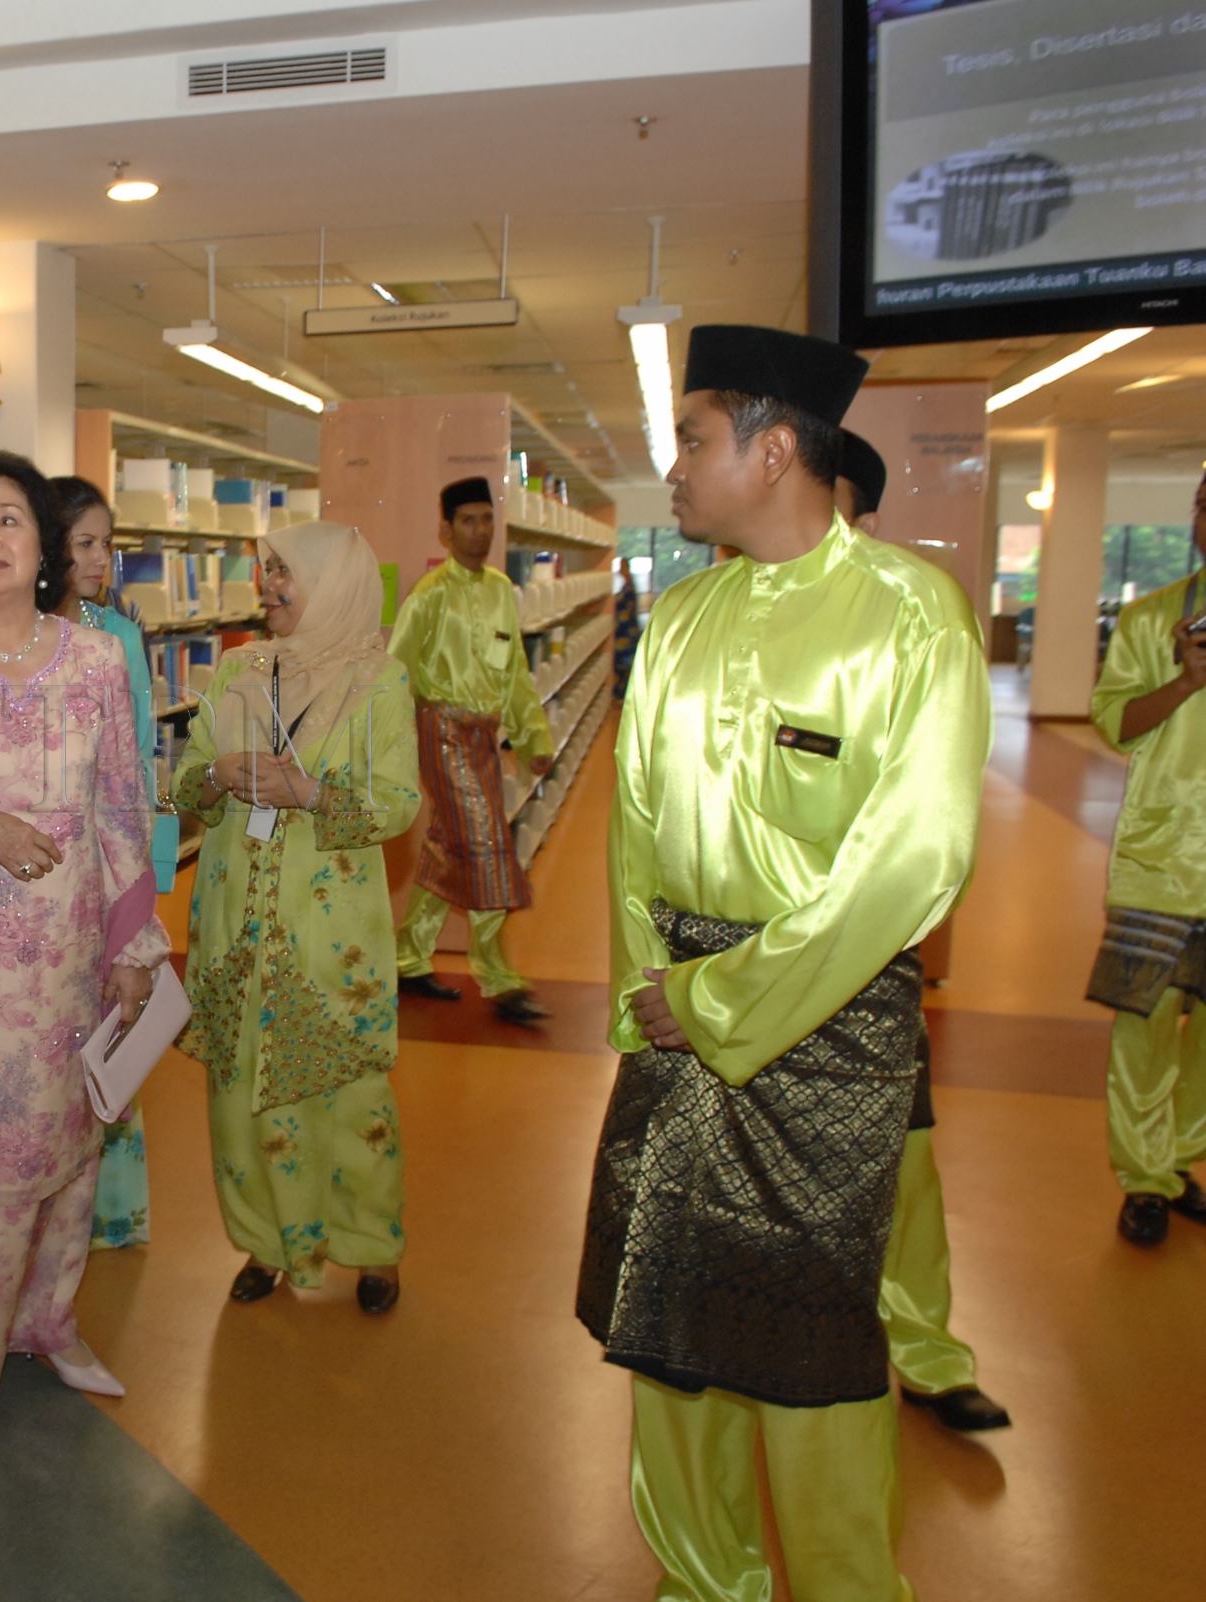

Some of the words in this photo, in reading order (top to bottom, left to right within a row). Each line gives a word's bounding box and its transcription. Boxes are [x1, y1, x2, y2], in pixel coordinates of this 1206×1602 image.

[1030, 16, 1162, 61] Disertasi
[937, 270, 1080, 300] Perpustakaan
[1085, 261, 1169, 284] Tuanku
[409, 308, 450, 322] Rujukan
